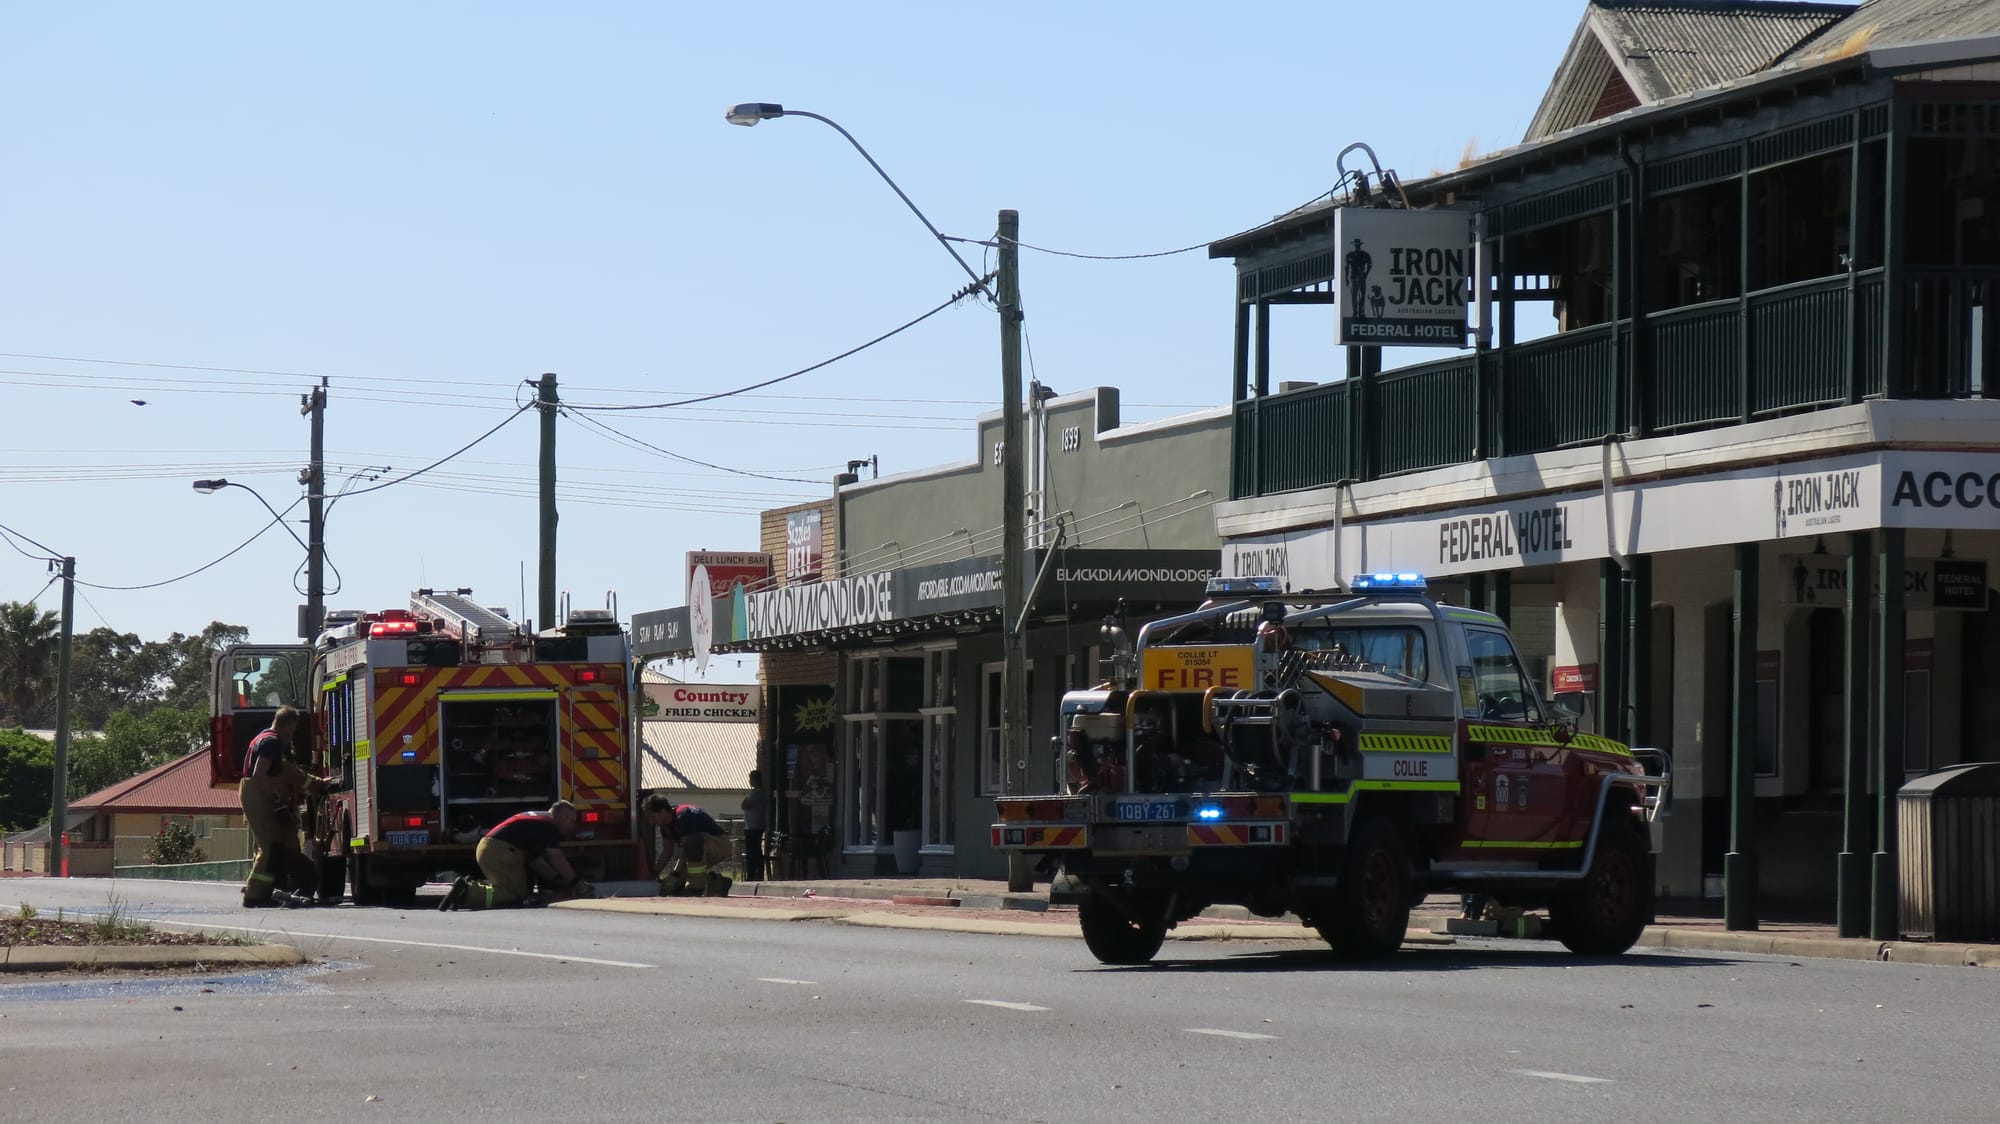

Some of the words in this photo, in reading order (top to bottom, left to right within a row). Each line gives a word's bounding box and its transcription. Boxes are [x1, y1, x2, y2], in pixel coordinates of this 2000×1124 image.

[1389, 248, 1464, 276] IRON
[1388, 276, 1465, 307] JACK
[1350, 324, 1412, 337] FEDERAL
[1415, 325, 1458, 338] HOTEL
[1062, 426, 1080, 450] 1899
[1787, 476, 1822, 516] IRON
[1824, 471, 1860, 511] JACK
[1440, 514, 1513, 564] FEDERAL
[1518, 506, 1572, 555] HOTEL
[693, 555, 713, 564] DELI
[716, 556, 744, 564] LUNCH
[748, 556, 765, 565] BAR
[787, 545, 811, 578] DELI
[1242, 550, 1263, 577] IRON
[1264, 547, 1286, 577] JACK
[917, 577, 949, 601] AFFORDABLE
[1936, 574, 1985, 585] FEDERAL
[1944, 586, 1976, 596] HOTEL
[747, 572, 892, 640] BLACKDIAMONDLODGE
[1177, 651, 1206, 660] COLLIE
[1158, 667, 1239, 689] FIRE
[673, 689, 749, 705] Country
[665, 707, 700, 717] FRIED
[703, 708, 756, 718] CHICKEN
[804, 714, 828, 725] OPEN
[1393, 760, 1428, 777] COLLIE
